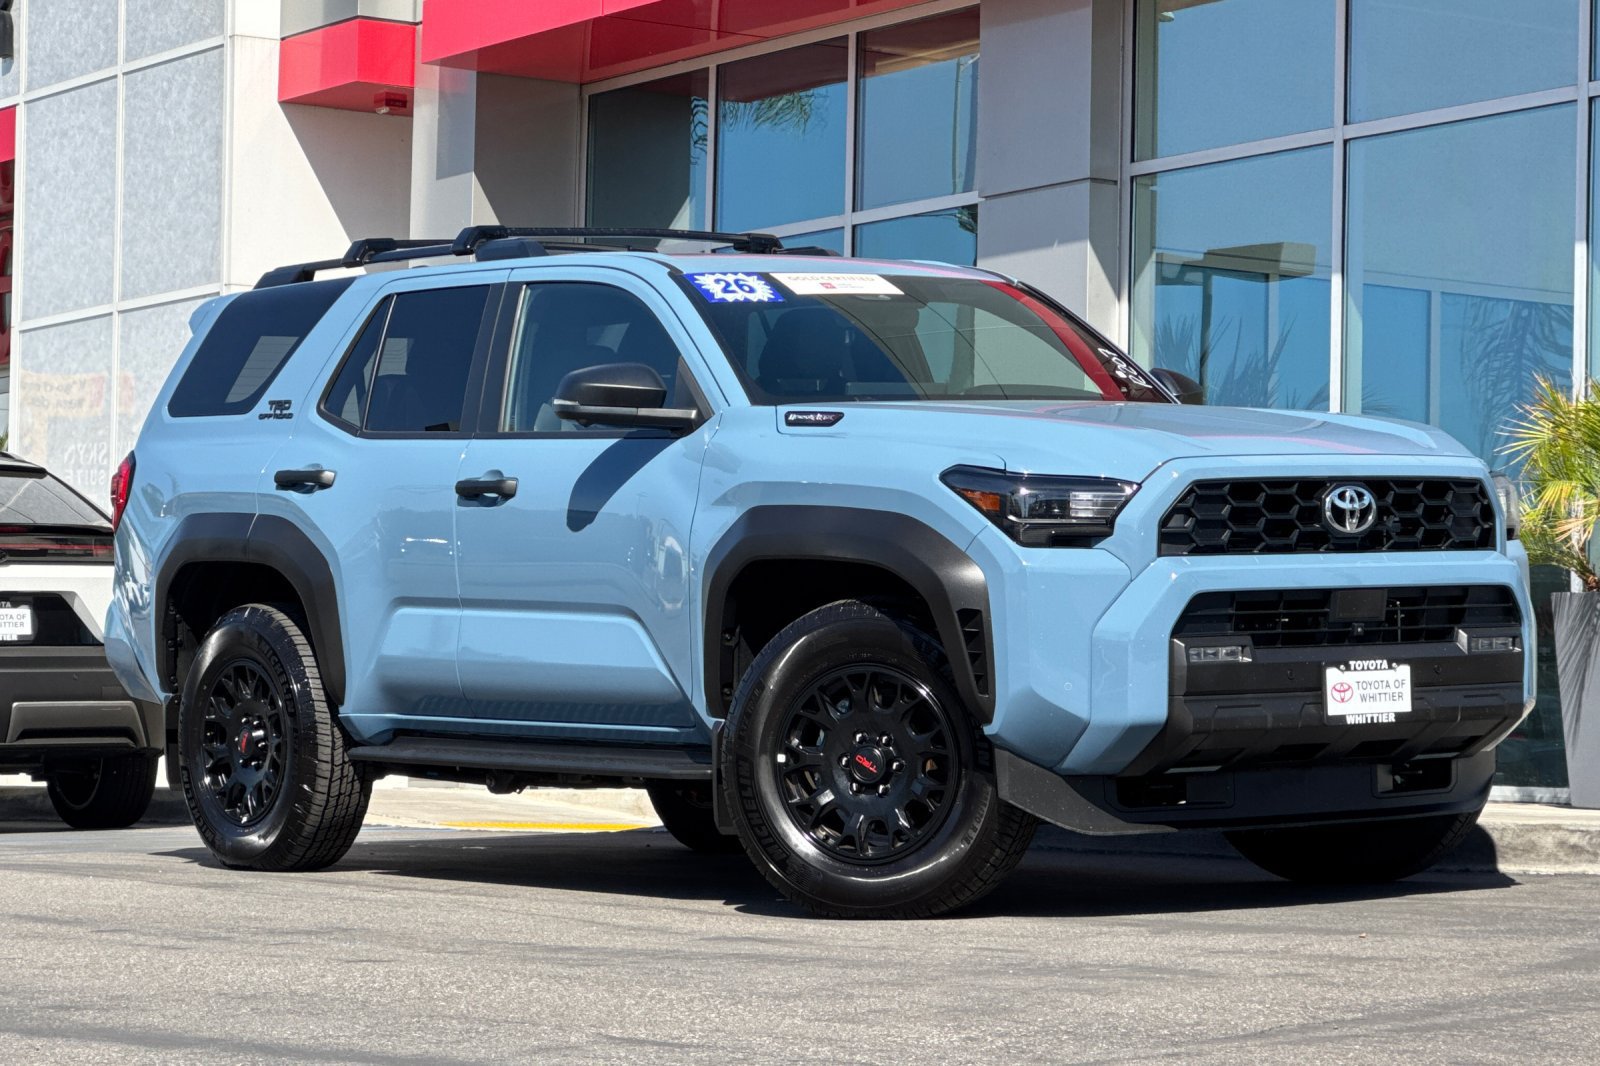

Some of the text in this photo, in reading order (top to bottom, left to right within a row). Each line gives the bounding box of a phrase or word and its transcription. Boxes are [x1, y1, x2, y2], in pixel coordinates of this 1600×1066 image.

[714, 279, 757, 294] 26
[1349, 659, 1388, 670] TOYOTA
[1356, 679, 1406, 690] TOYOTA OF
[1360, 692, 1403, 702] WHITTIER
[1346, 712, 1395, 724] WHITTIER
[855, 754, 878, 774] TRD
[737, 757, 791, 860] MICHELIN
